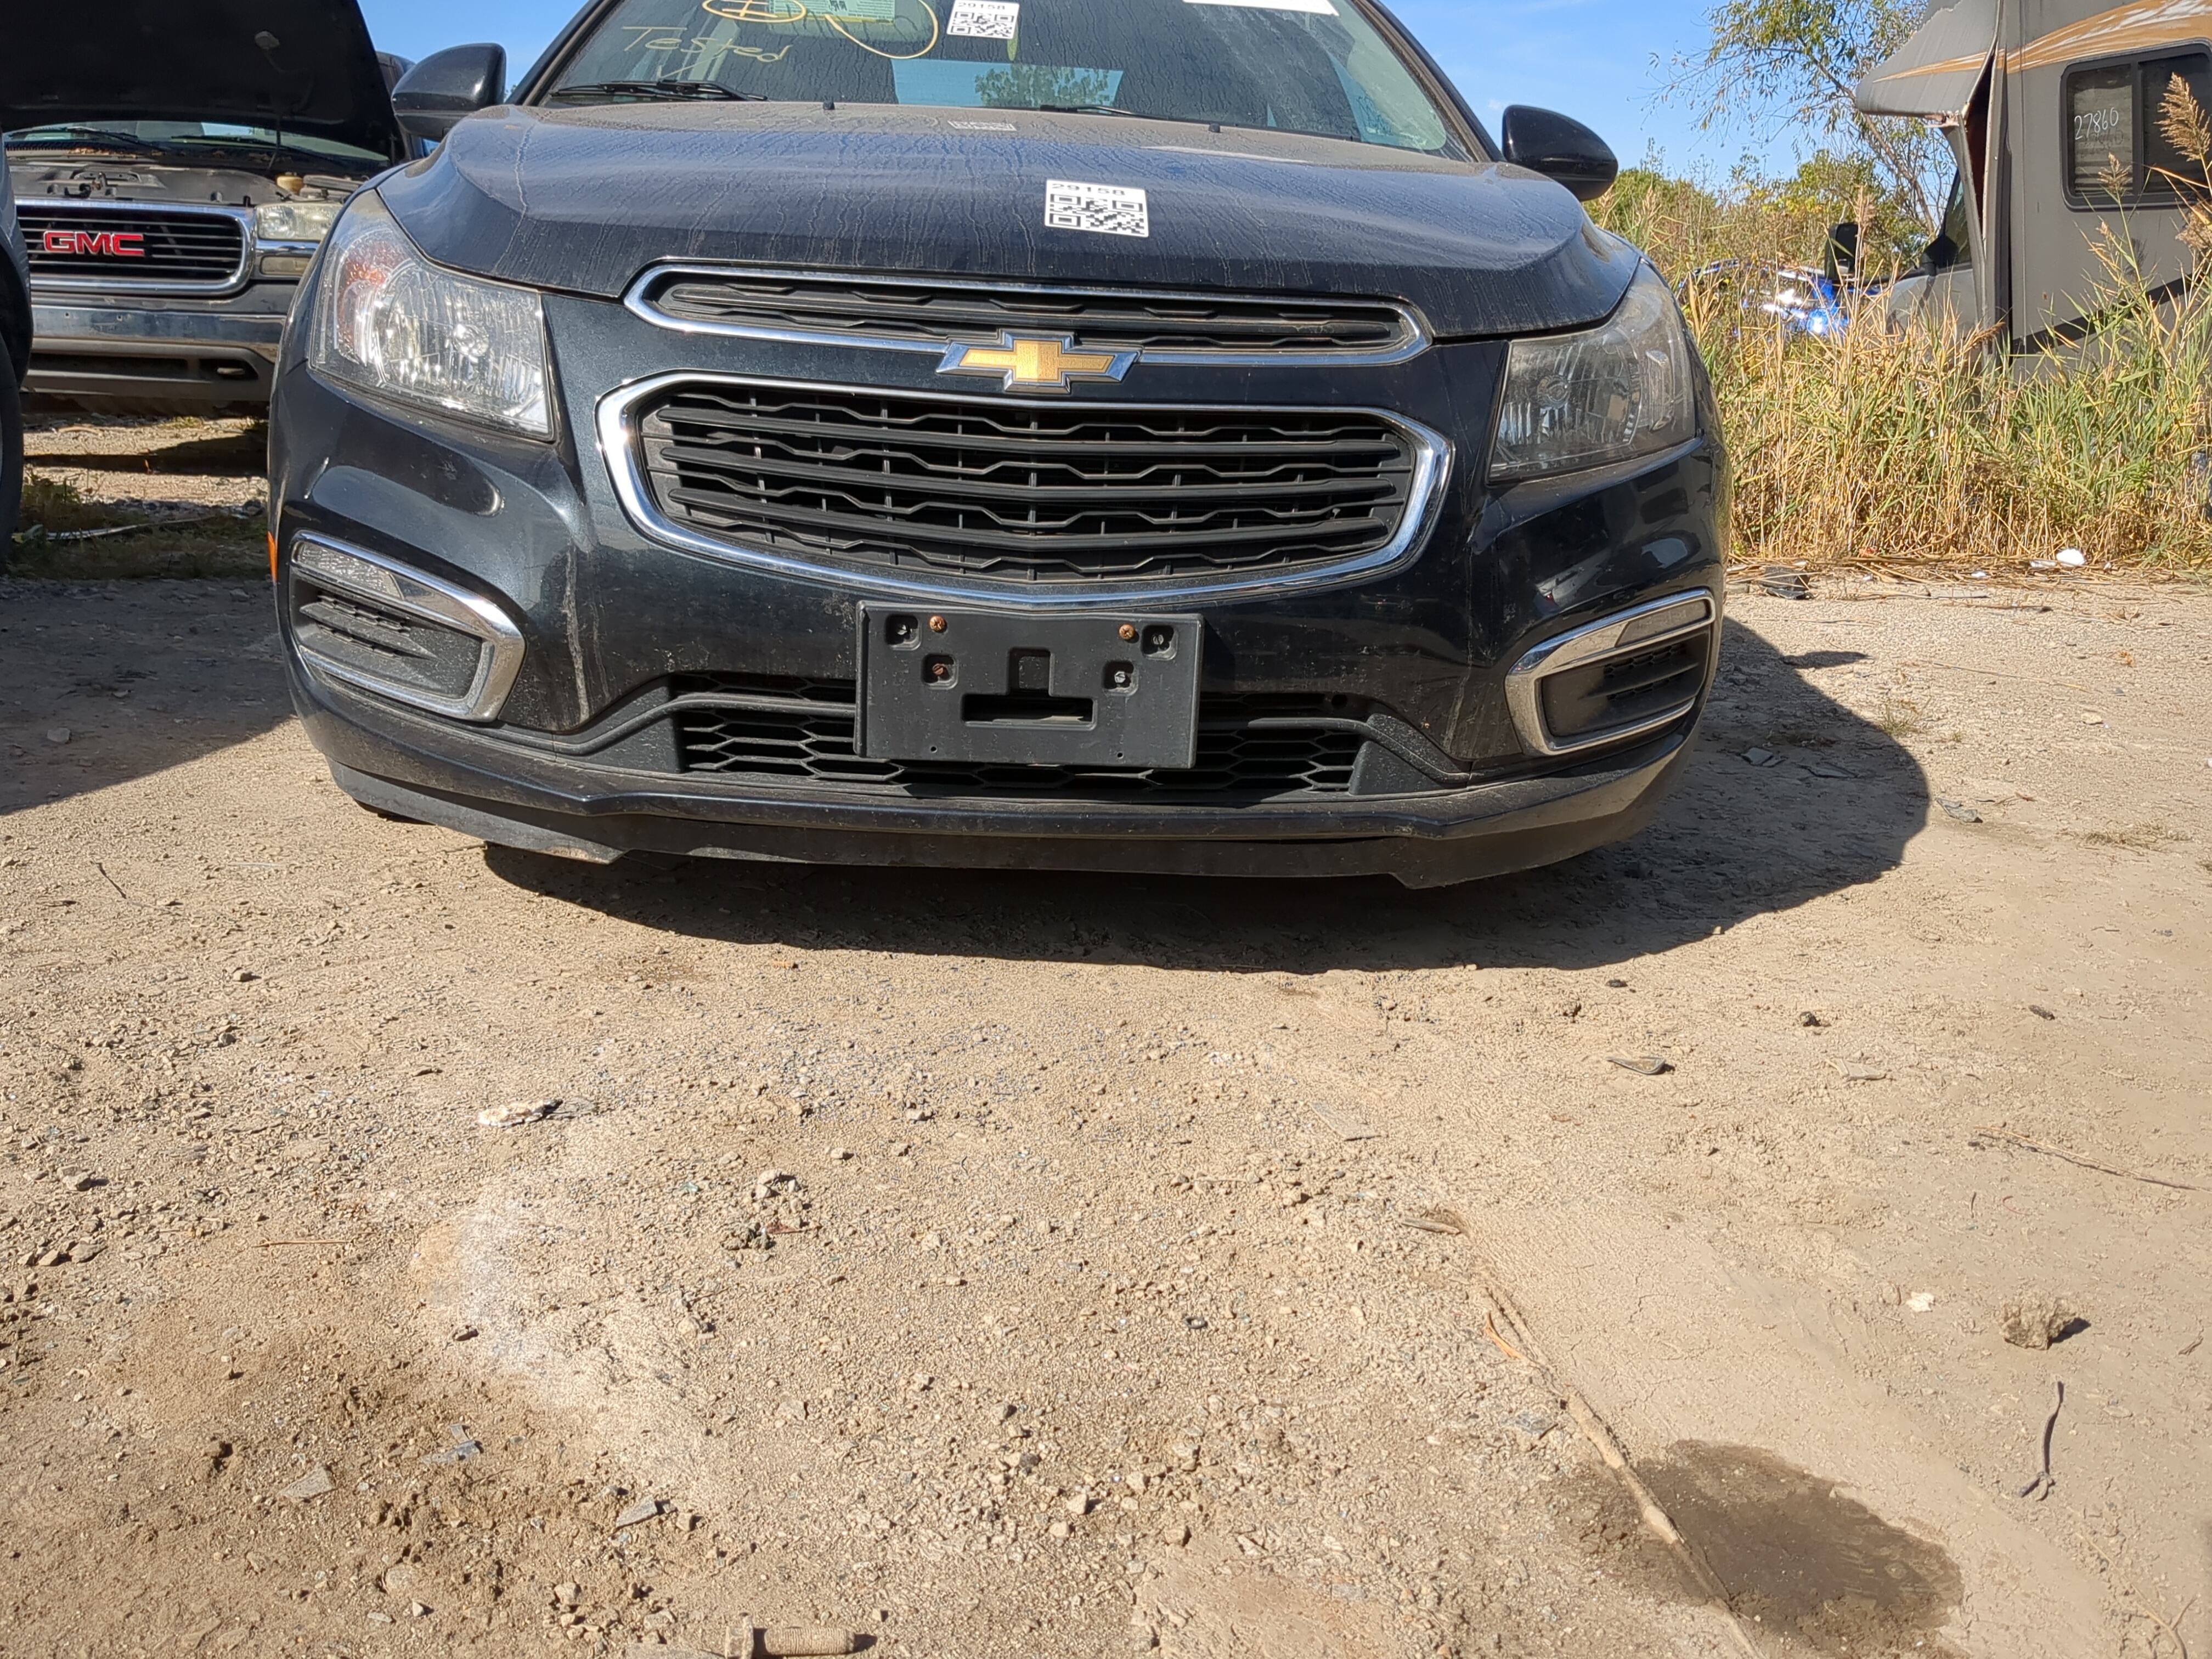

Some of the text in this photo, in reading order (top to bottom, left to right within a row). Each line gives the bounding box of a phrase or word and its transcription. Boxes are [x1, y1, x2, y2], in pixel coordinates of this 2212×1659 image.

[622, 26, 793, 62] Tested
[2074, 107, 2119, 140] 27860
[1052, 183, 1125, 195] 29158
[43, 230, 144, 256] GMC
